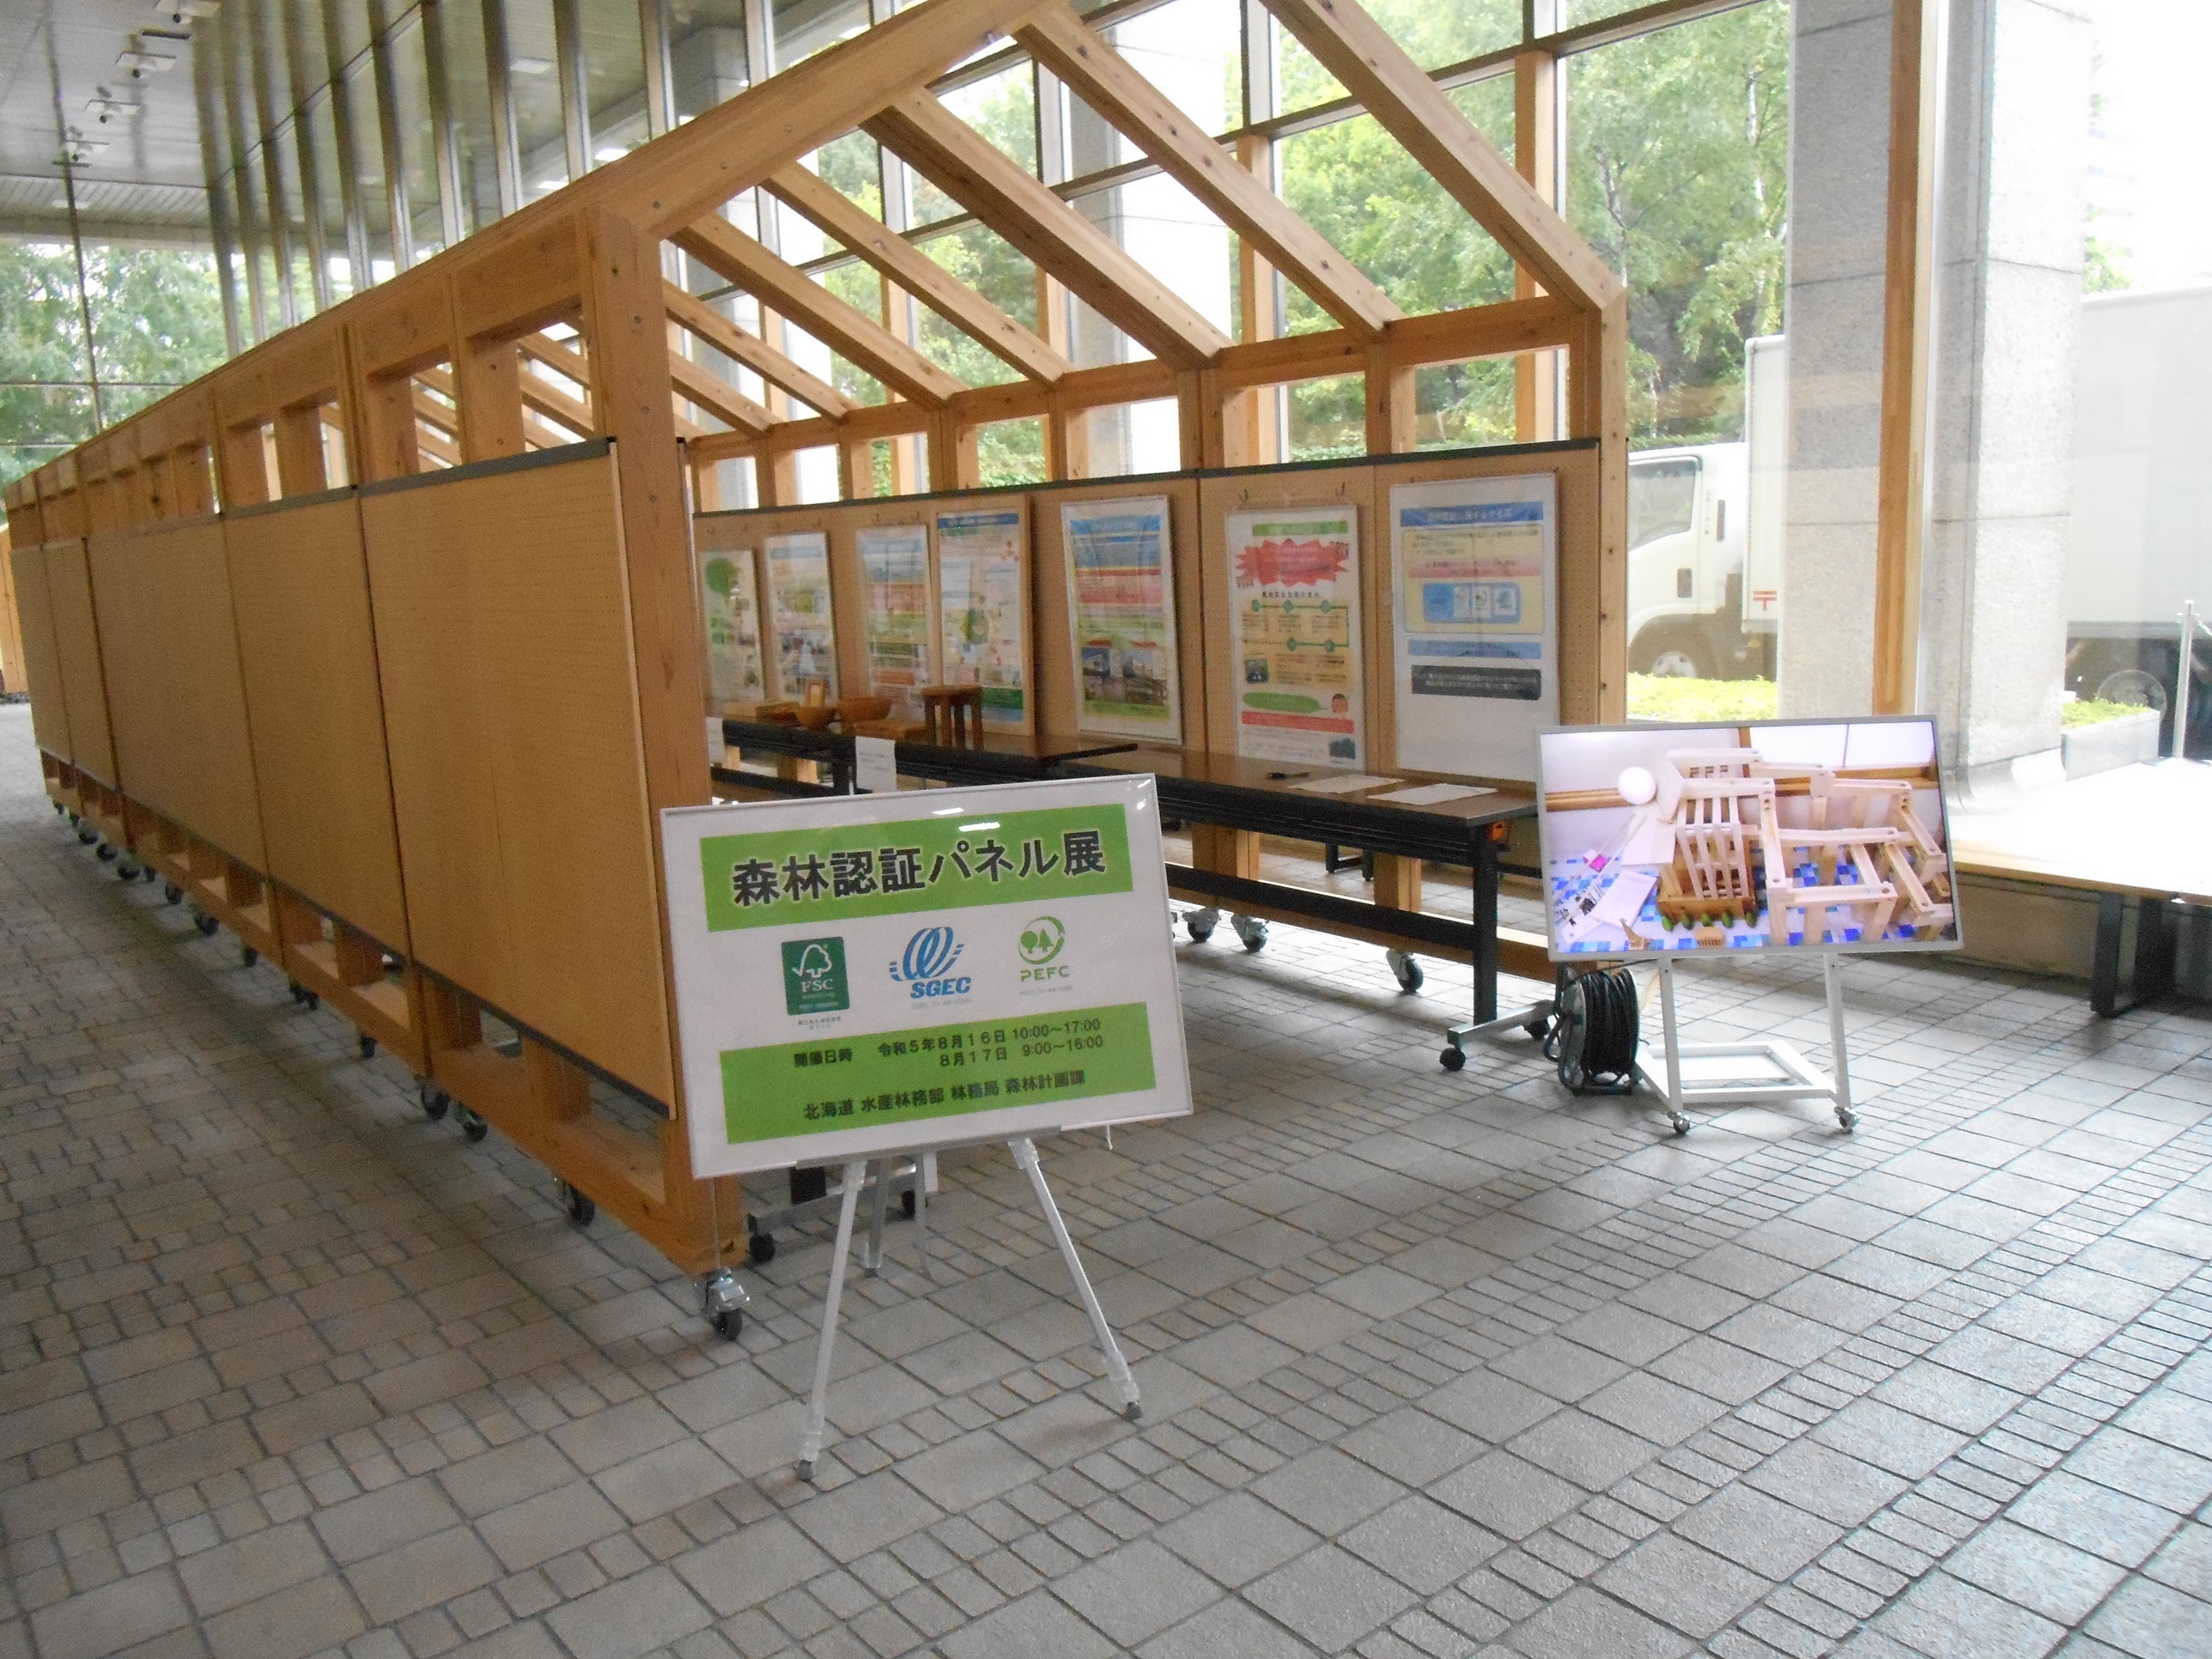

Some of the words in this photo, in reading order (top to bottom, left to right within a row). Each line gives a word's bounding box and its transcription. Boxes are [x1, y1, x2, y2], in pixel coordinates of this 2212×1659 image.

[732, 830, 1105, 907] 森林認証パネル展
[1020, 965, 1070, 982] PEFC
[801, 978, 833, 993] FSC
[910, 976, 971, 999] SGEC
[804, 1098, 854, 1120] 北海道
[861, 1087, 945, 1112] 水産林務部
[951, 1080, 1000, 1101] 林務局
[1006, 1069, 1085, 1094] 森林計画課
